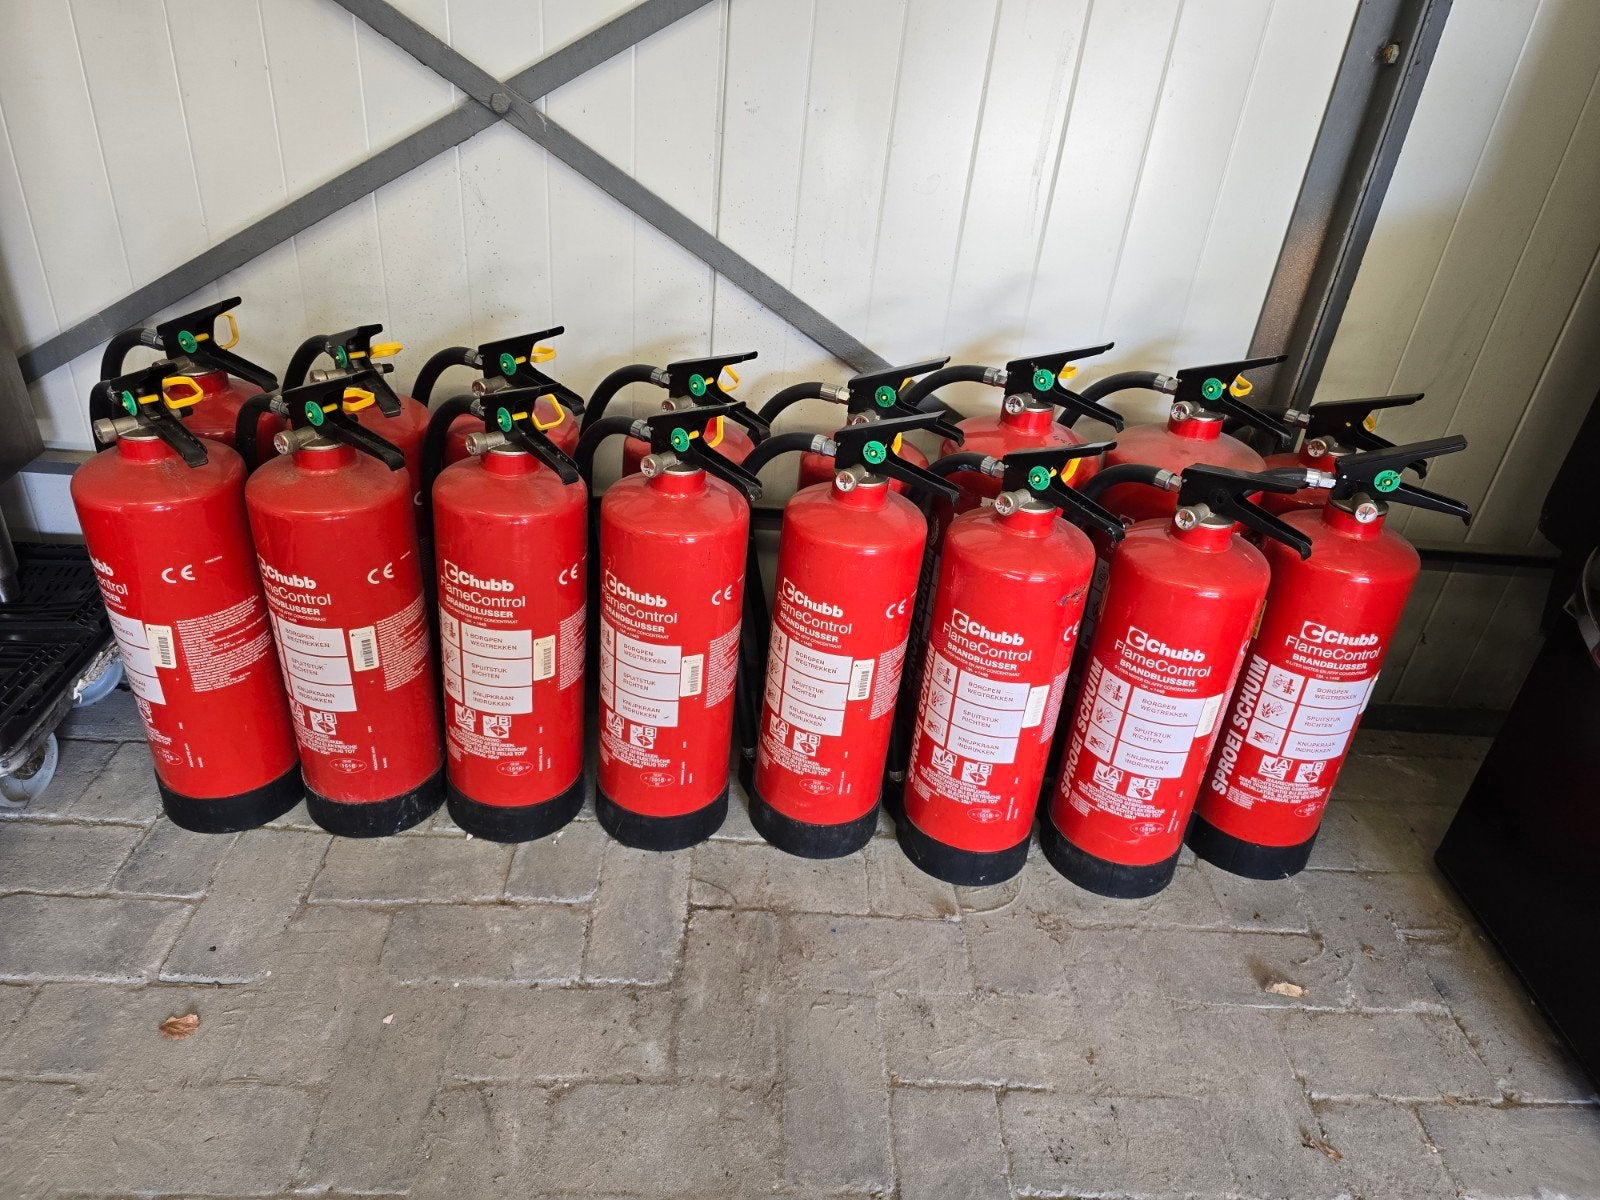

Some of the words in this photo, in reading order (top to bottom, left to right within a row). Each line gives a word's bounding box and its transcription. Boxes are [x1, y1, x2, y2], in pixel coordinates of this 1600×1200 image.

[161, 564, 196, 584] CE
[266, 565, 317, 590] Chubb
[367, 562, 395, 585] CE
[558, 563, 578, 585] CE
[458, 571, 515, 592] Chubb
[441, 575, 526, 608] FlameControl
[617, 582, 668, 608] Chubb
[712, 584, 732, 606] CE
[446, 594, 513, 618] BRANDBLUSSER
[602, 583, 678, 624] FlameControl
[794, 590, 844, 618] Chubb
[886, 599, 906, 619] CE
[604, 603, 665, 633] BRANDBLUSSER
[777, 590, 853, 635] FlameControl
[780, 610, 839, 643] BRANDBLUSSER
[968, 621, 1025, 646] Chubb
[286, 635, 330, 648] WEGTREKKEN
[469, 632, 503, 644] BORGPEN
[943, 622, 1032, 661] FlameControl
[1324, 629, 1379, 646] Chubb
[470, 640, 517, 651] WEGTREKKEN
[623, 643, 654, 657] BORGPEN
[1146, 638, 1206, 663] Chubb
[1284, 634, 1382, 661] FlameControl
[624, 650, 667, 665] WEGTREKKEN
[795, 650, 825, 665] BORGPEN
[947, 641, 1018, 670] BRANDBLUSSER
[1114, 639, 1212, 678] FlameControl
[1292, 653, 1368, 670] BRANDBLUSSER
[471, 663, 508, 674] SPUITSTUK
[795, 657, 837, 674] WEGTREKKEN
[1119, 659, 1196, 687] BRANDBLUSSER
[471, 670, 500, 680] RICHTEN
[623, 672, 656, 686] SPUITSTUK
[623, 679, 649, 691] RICHTEN
[791, 685, 817, 699] RICHTEN
[792, 678, 825, 694] SPUITSTUK
[968, 681, 1001, 694] BORGPEN
[472, 690, 514, 701] KNIJPKRAAN
[472, 697, 511, 707] INDRUKKEN
[967, 688, 1014, 702] WEGTREKKEN
[622, 698, 661, 713] KNIJPKRAAN
[622, 705, 657, 719] INDRUKKEN
[908, 721, 922, 783] SPROEI
[918, 640, 936, 718] SCHUIM
[1140, 704, 1189, 718] WEGTREKKEN
[1141, 698, 1177, 711] BORGPEN
[323, 712, 335, 723] B
[465, 709, 475, 720] A
[499, 717, 509, 726] B
[788, 705, 827, 723] KNIJPKRAAN
[788, 711, 823, 728] INDRUKKEN
[962, 709, 999, 724] SPUITSTUK
[961, 716, 991, 728] RICHTEN
[1060, 732, 1083, 798] SPROEI
[1077, 656, 1103, 733] SCHUIM
[1212, 729, 1244, 795] SPROEI
[1233, 654, 1269, 730] SCHUIM
[645, 727, 655, 737] B
[808, 734, 819, 745] B
[1132, 732, 1163, 744] RICHTEN
[1133, 726, 1172, 739] SPUITSTUK
[957, 742, 996, 756] INDRUKKEN
[958, 736, 1000, 750] KNIJPKRAAN
[944, 752, 955, 764] A
[1124, 758, 1165, 771] INDRUKKEN
[1126, 752, 1170, 765] KNIJPKRAAN
[1278, 759, 1289, 769] A
[980, 764, 991, 774] B
[1313, 761, 1324, 771] B
[1108, 769, 1121, 780] A
[1147, 779, 1158, 788] B
